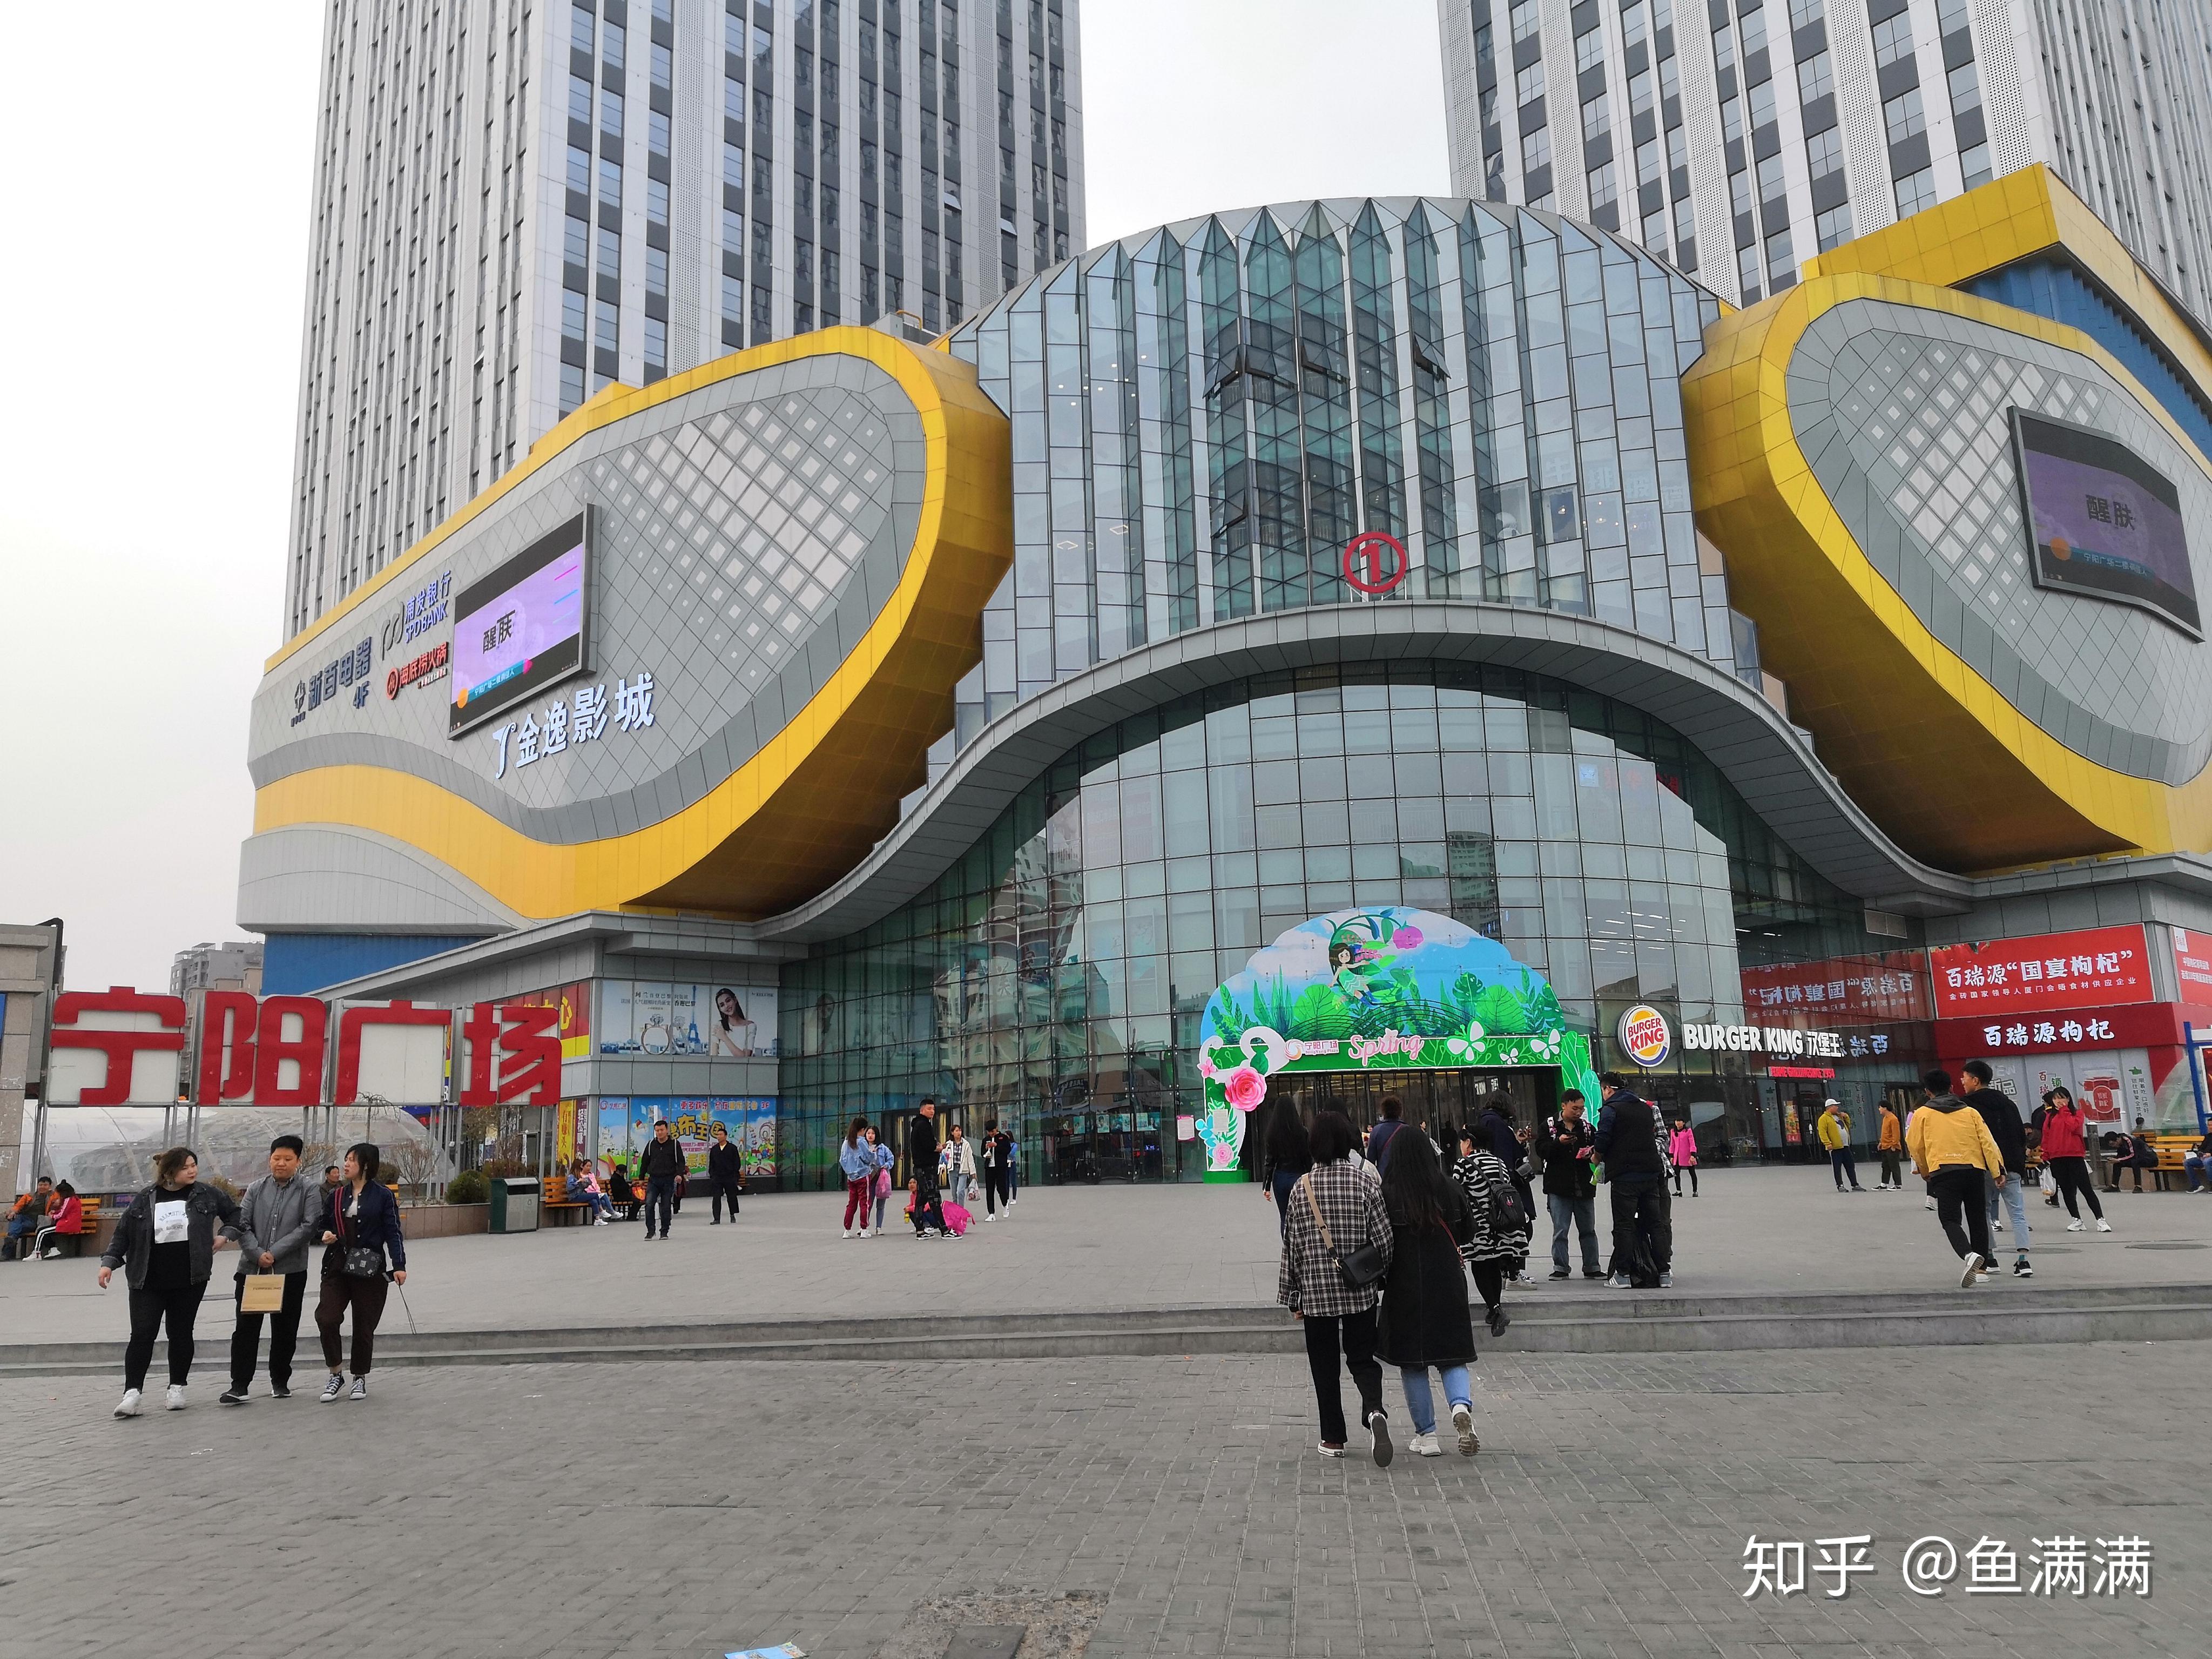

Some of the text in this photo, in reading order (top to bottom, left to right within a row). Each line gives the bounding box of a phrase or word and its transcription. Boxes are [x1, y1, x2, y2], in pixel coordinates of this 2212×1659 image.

[405, 570, 451, 624] 浦发银行
[308, 637, 372, 711] 新百电器
[400, 642, 449, 688] 海底捞火锅
[353, 680, 370, 709] 4F
[516, 672, 655, 768] 金逸影城
[1950, 976, 2137, 1000] 金砖国家领导人厦门会晤食材供应企业
[1628, 1017, 1662, 1038] BURGER
[1630, 1028, 1664, 1053] KING
[1683, 1024, 1763, 1052] BURGER
[1764, 1027, 1803, 1055] KING
[1806, 1030, 1845, 1058] 汉堡王
[1983, 1019, 2115, 1047] 百瑞源枸杞
[50, 986, 562, 1106] 宁阳广场
[1304, 1041, 1338, 1050] 宁阳广场
[1348, 1034, 1425, 1067] Spring
